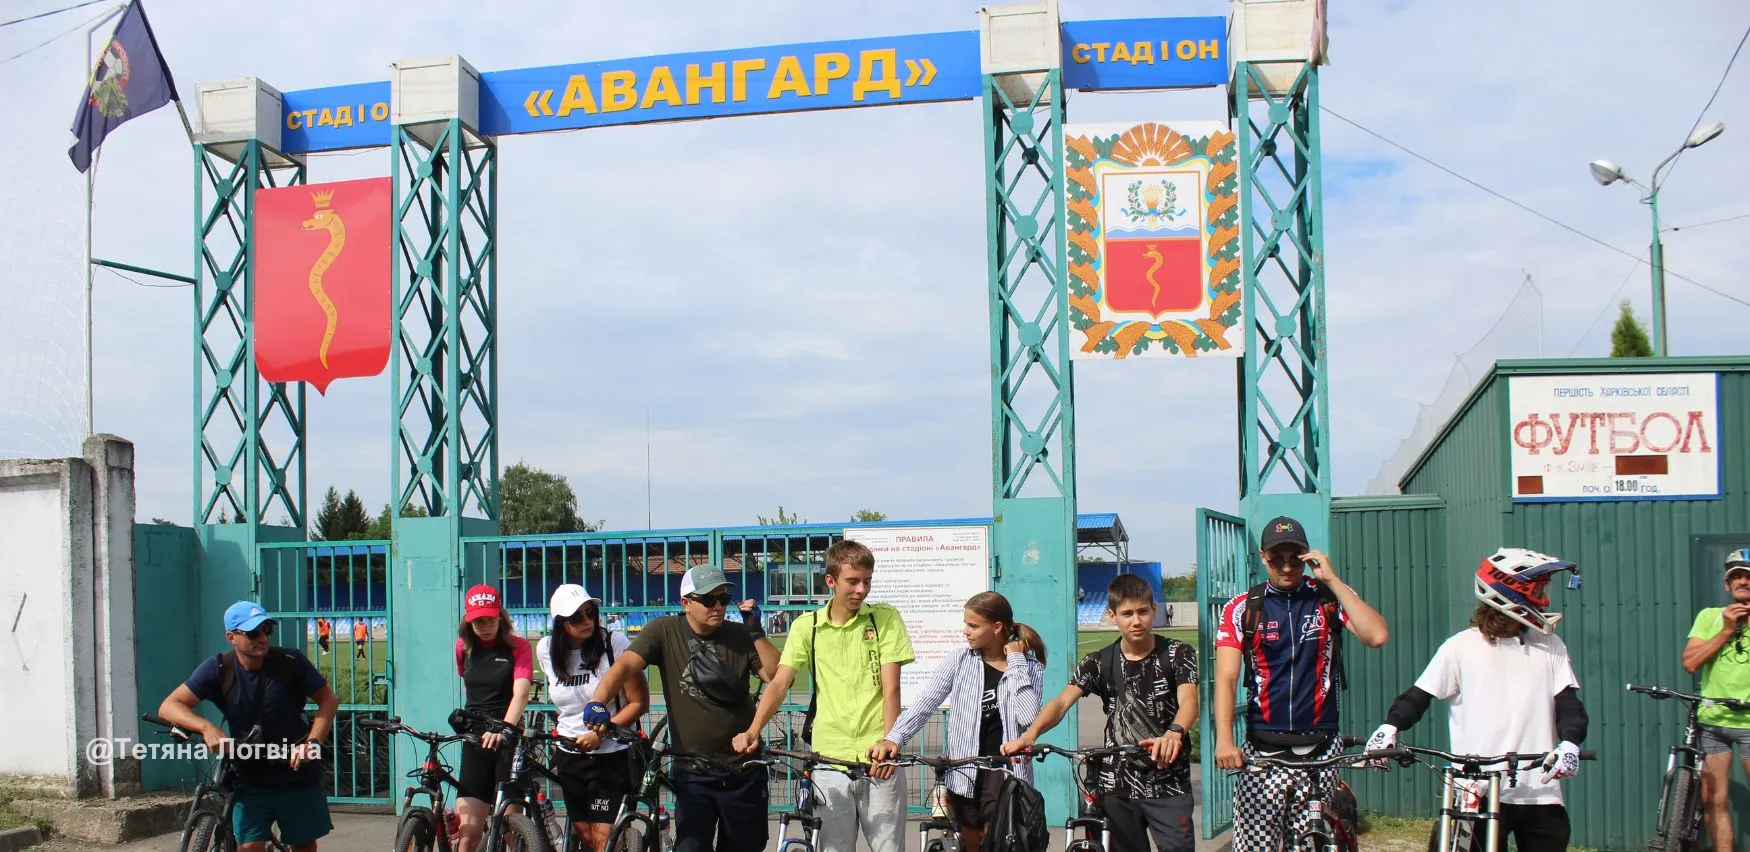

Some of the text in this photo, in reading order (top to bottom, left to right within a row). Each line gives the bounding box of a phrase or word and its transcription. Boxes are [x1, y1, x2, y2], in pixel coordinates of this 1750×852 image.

[1071, 39, 1219, 66] СТАДІОН
[523, 48, 938, 117] «АВАНГАРД»
[286, 102, 390, 129] СТАДІО
[1553, 386, 1594, 398] ПЕРШІСТЬ
[1656, 385, 1690, 397] ОБЛАСТІ
[1513, 411, 1712, 456] ФУТБОЛ
[1615, 479, 1638, 491] 18.00
[895, 535, 934, 543] ПРАВИЛА
[901, 544, 934, 553] стадіоні
[1487, 566, 1532, 593] 100%
[467, 592, 496, 606] CANADA
[555, 673, 590, 687] PUMA
